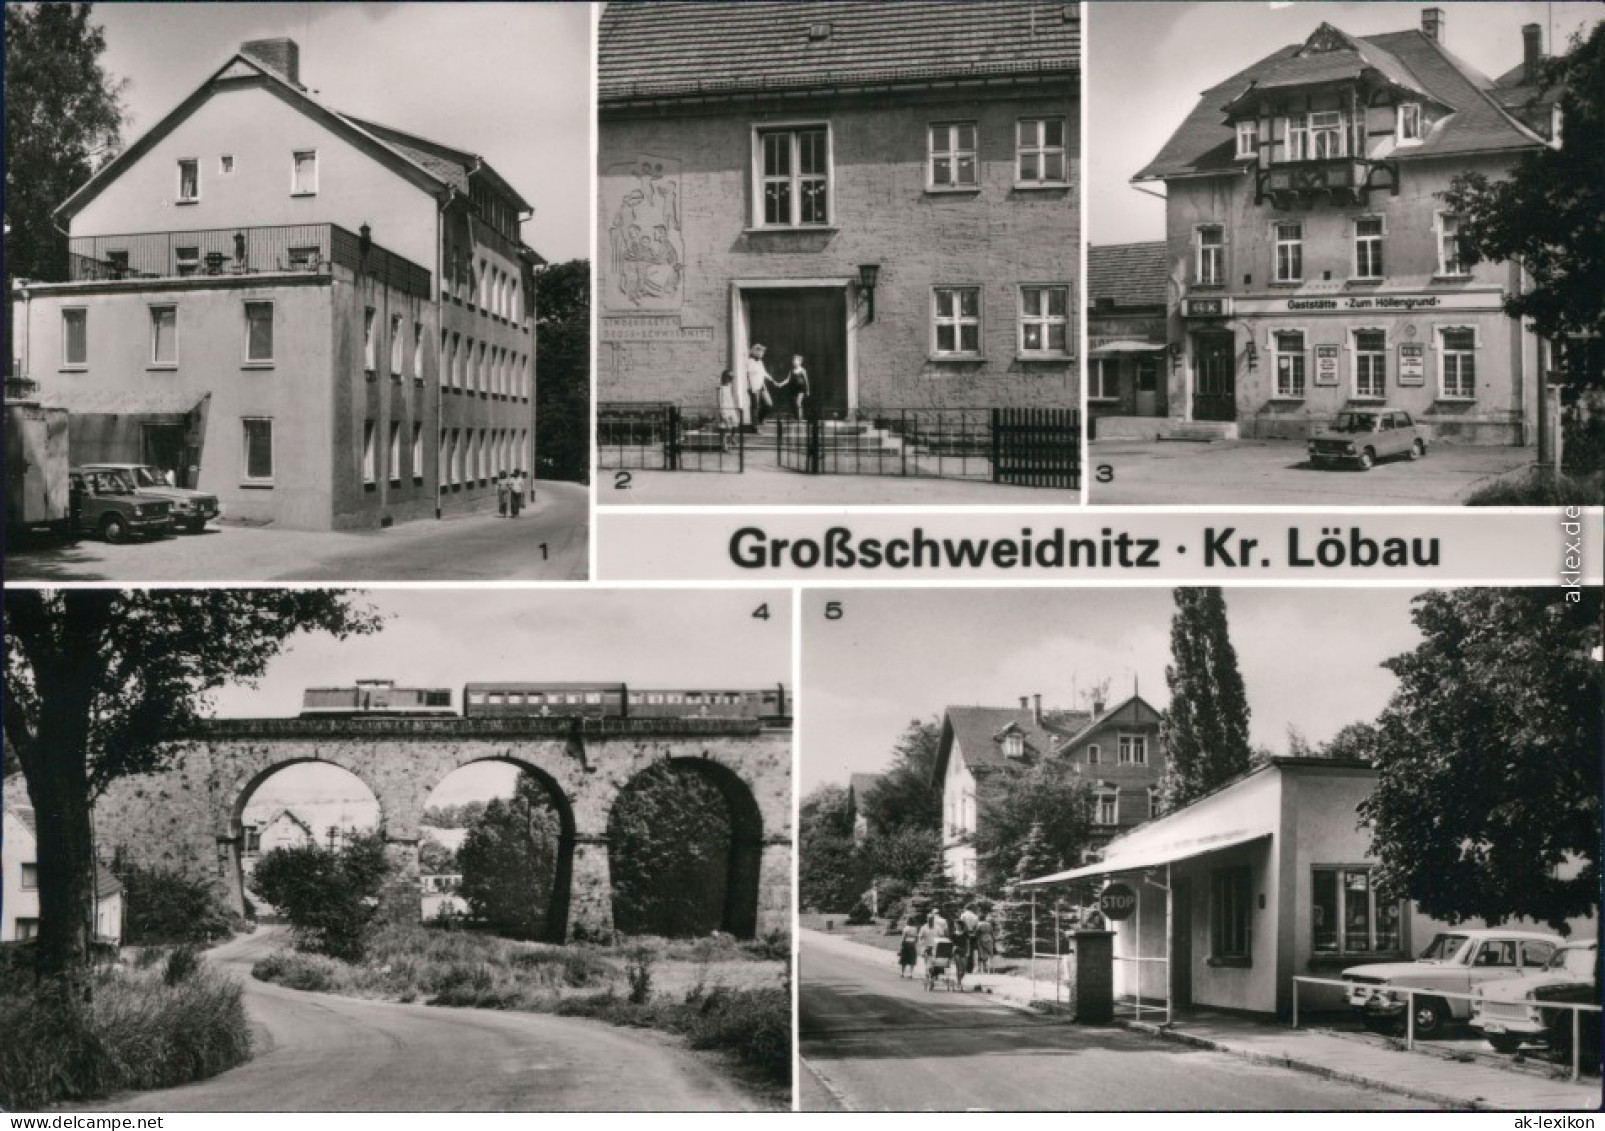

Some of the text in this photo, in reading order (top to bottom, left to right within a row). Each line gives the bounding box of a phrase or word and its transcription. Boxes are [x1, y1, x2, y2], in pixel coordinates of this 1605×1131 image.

[1095, 465, 1113, 482] 3
[538, 543, 547, 560] 1
[730, 528, 1439, 569] Großschweidnitz Kr. Löbau
[753, 604, 769, 619] 4
[825, 602, 842, 619] 5
[1102, 896, 1134, 908] STOP
